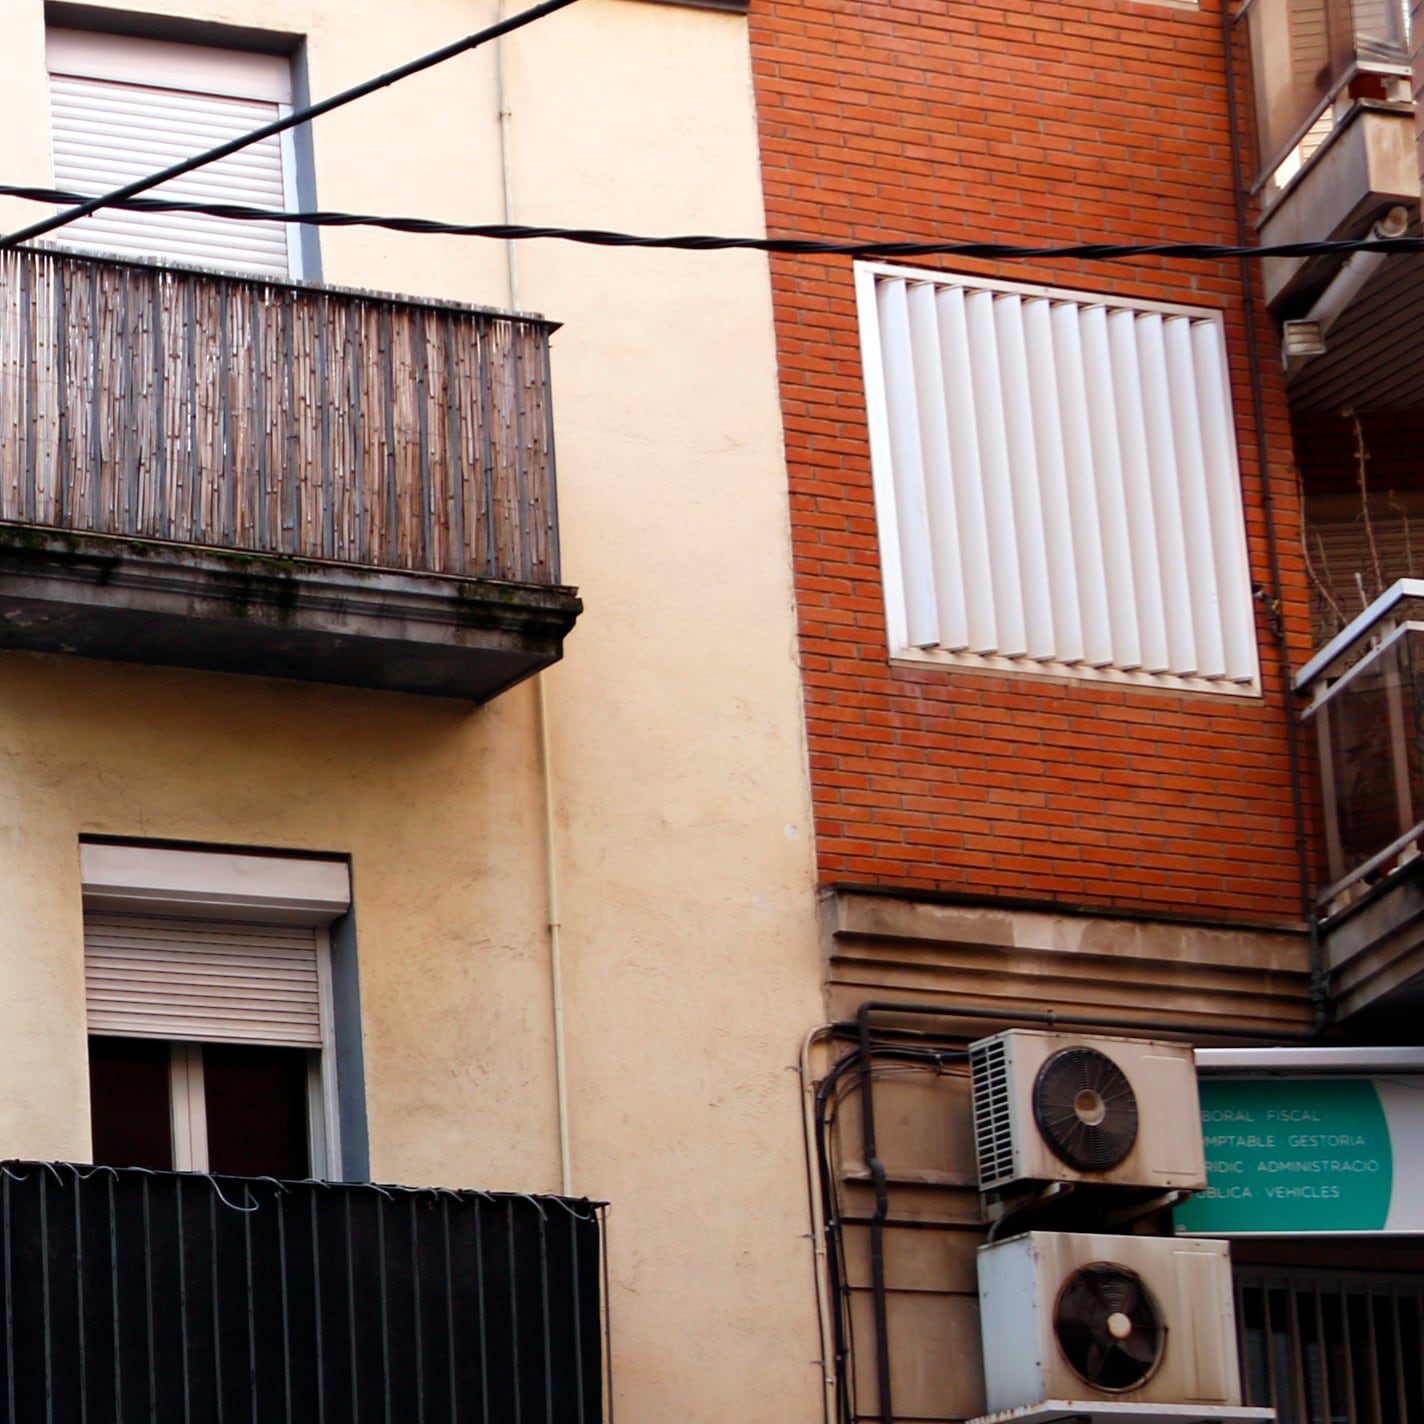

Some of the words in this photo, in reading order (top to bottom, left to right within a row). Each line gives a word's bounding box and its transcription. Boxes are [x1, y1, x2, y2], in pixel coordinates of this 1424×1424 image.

[1267, 1109, 1320, 1122] FISCAL
[1203, 1135, 1275, 1148] MPTABLE
[1288, 1135, 1365, 1147] GESTORIA
[1266, 1186, 1340, 1198] VEHICLES
